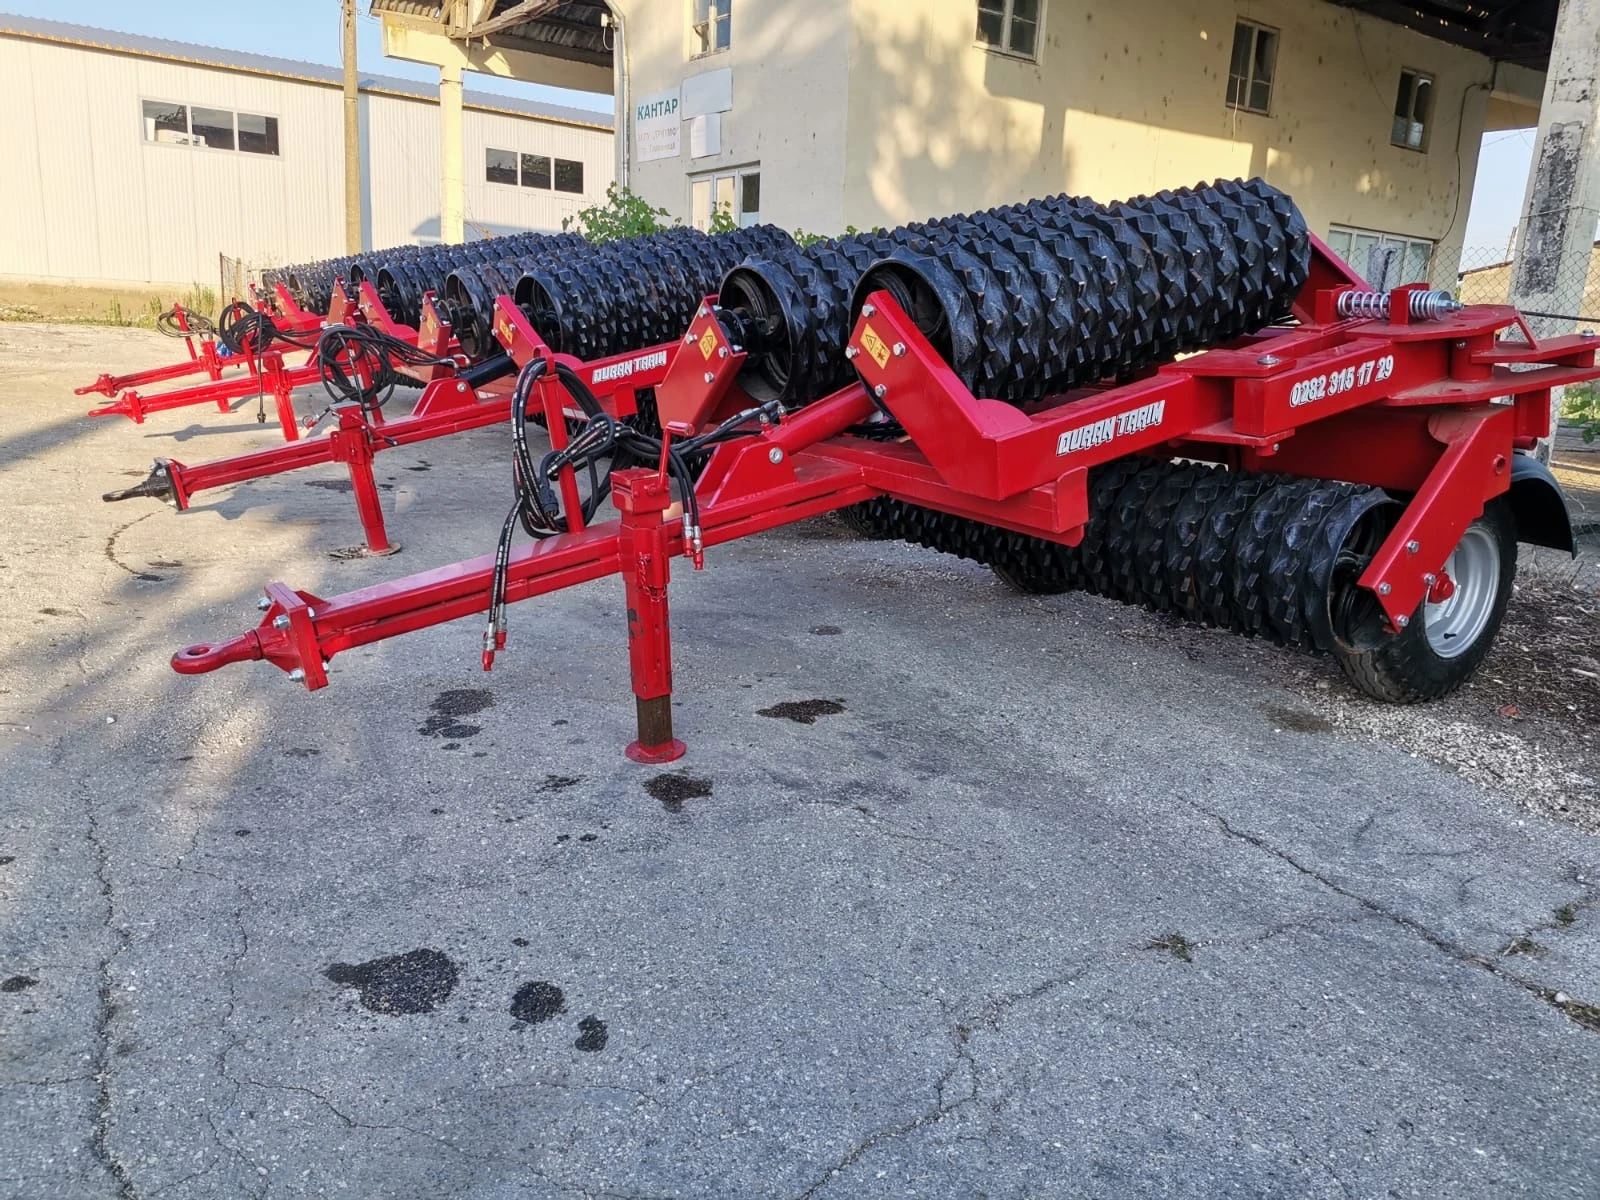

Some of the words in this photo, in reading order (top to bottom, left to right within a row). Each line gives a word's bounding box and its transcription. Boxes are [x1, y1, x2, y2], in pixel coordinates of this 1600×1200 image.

[637, 98, 679, 121] КАНТАР
[1290, 375, 1327, 408] 0282
[1327, 366, 1356, 396] 315
[1357, 360, 1375, 387] 17
[1375, 355, 1394, 382] 29
[1056, 416, 1117, 457] DURAN
[1116, 400, 1166, 437] TARIM
